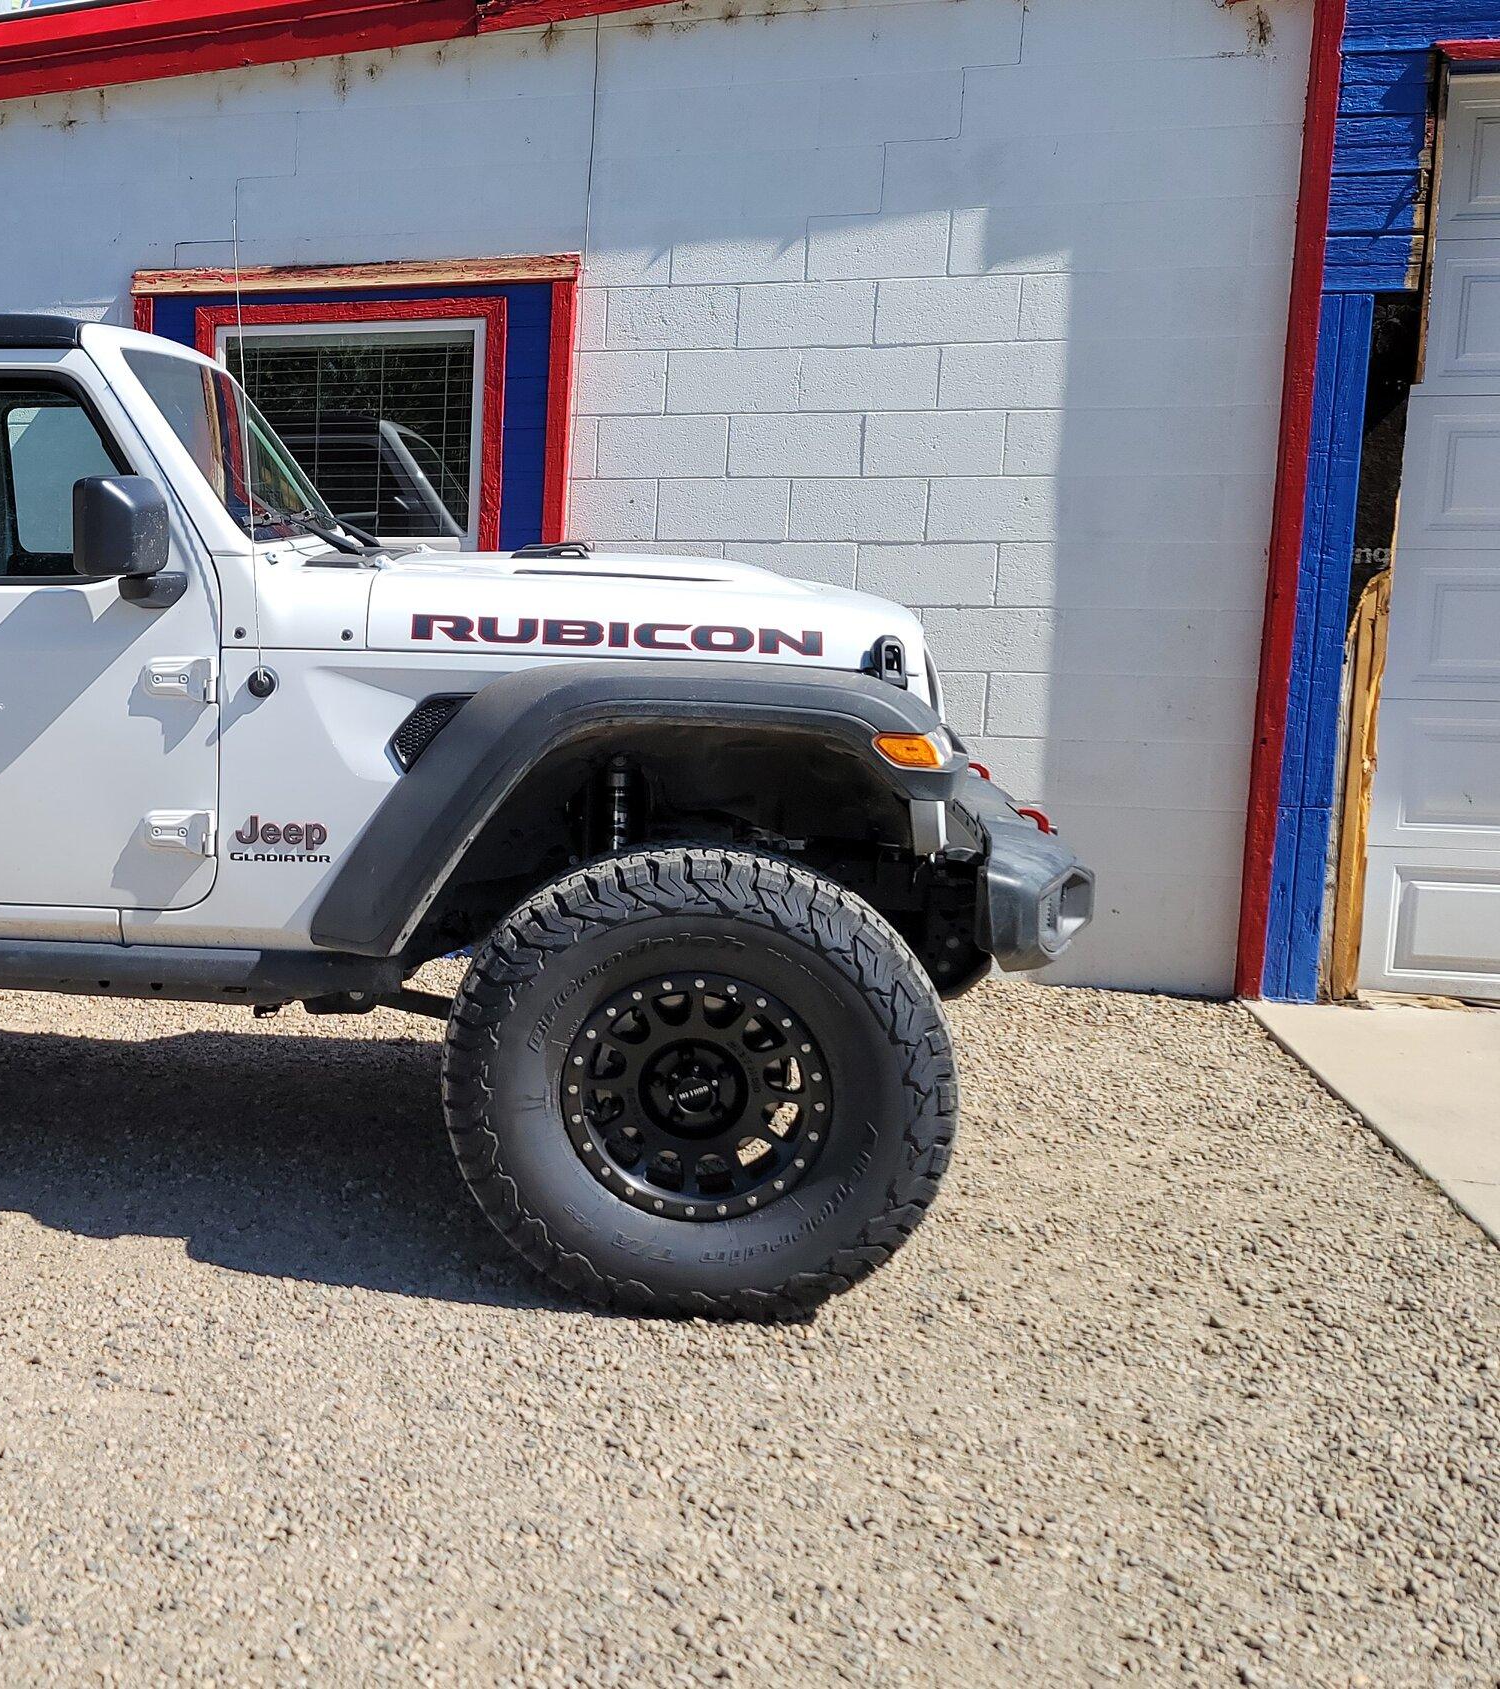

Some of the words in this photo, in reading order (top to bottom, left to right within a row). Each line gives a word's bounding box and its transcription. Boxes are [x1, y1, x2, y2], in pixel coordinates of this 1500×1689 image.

[411, 613, 823, 657] RUBICON
[234, 814, 328, 850] Jeep
[229, 851, 332, 864] GLADIATOR
